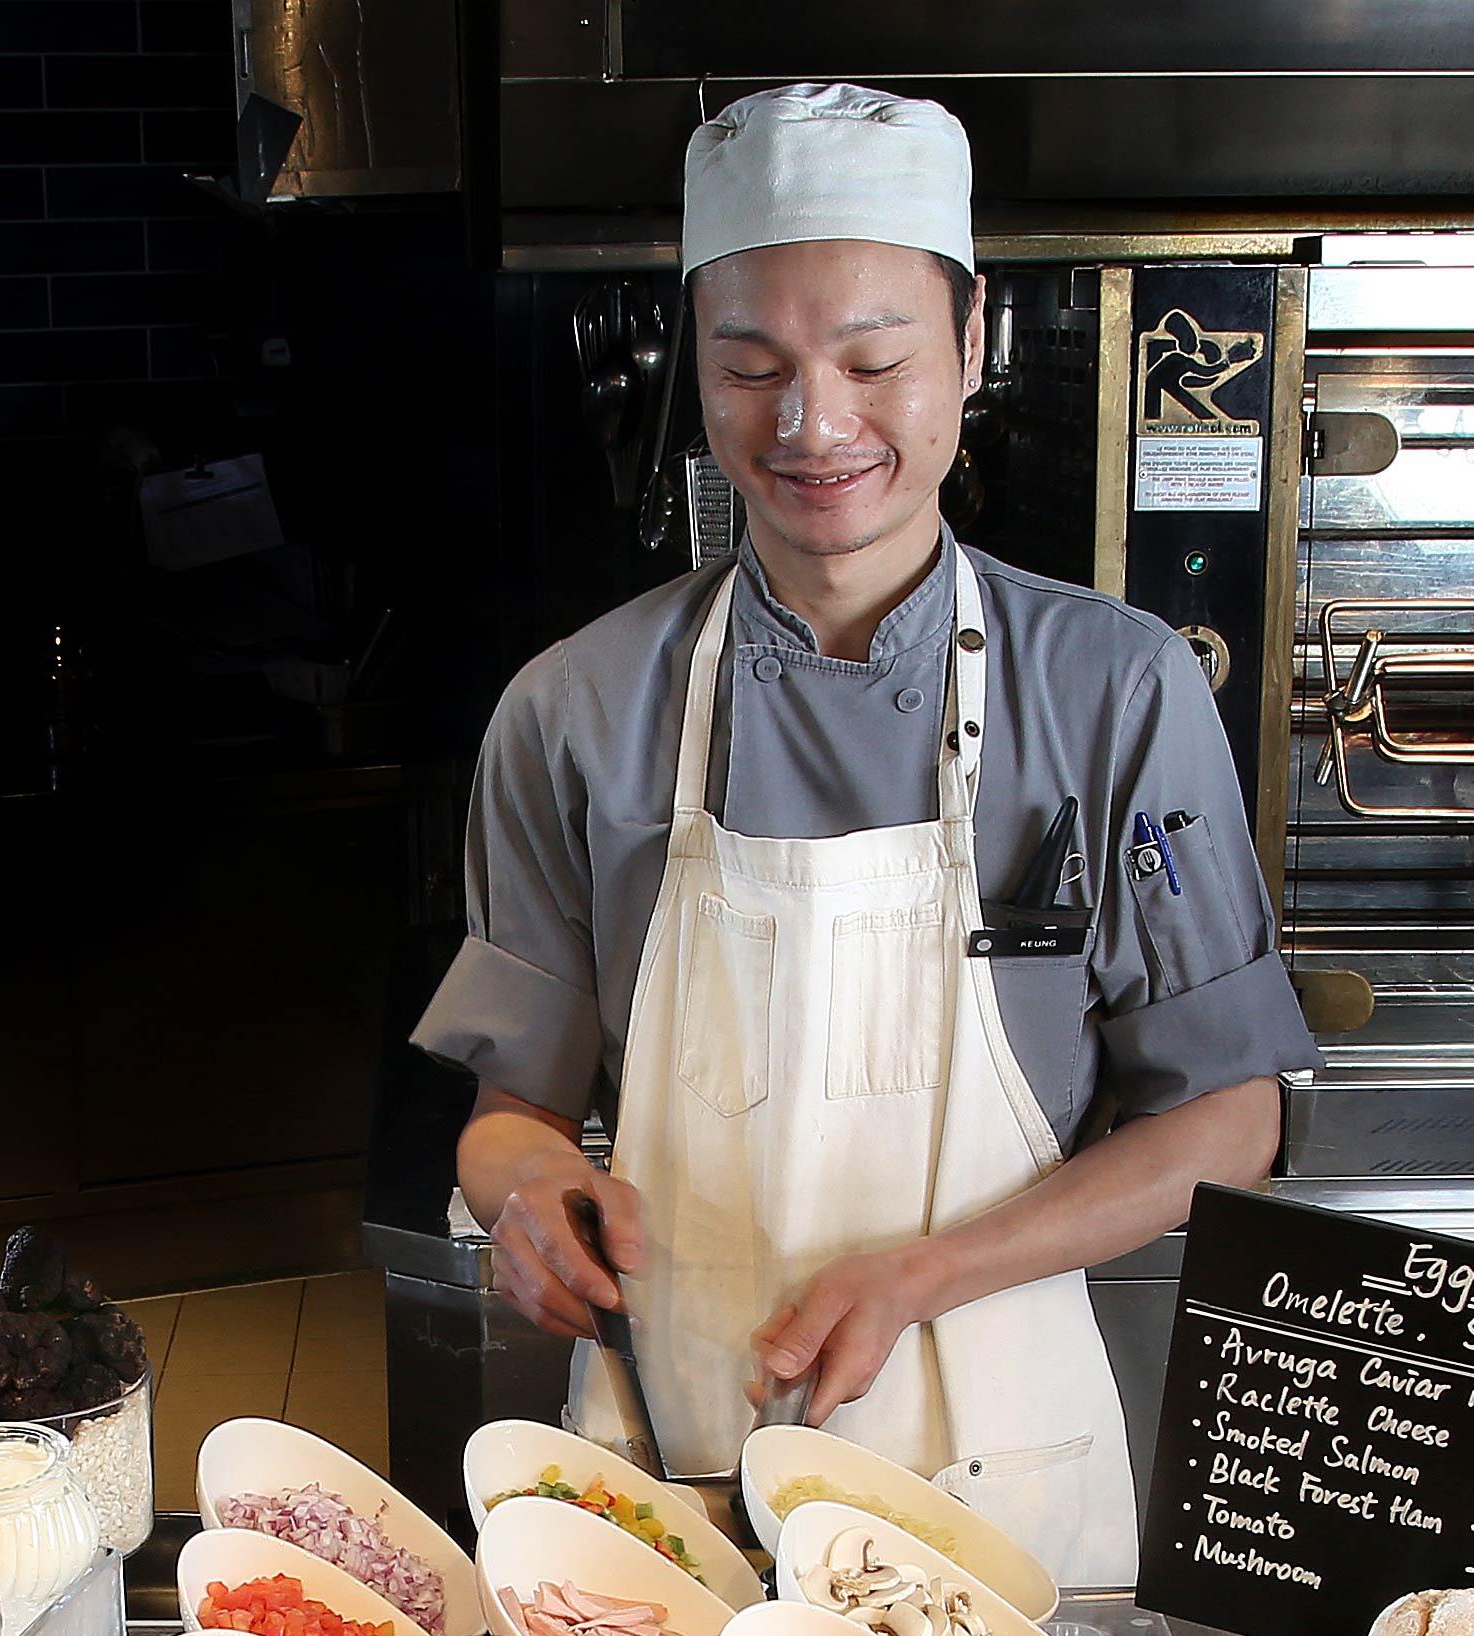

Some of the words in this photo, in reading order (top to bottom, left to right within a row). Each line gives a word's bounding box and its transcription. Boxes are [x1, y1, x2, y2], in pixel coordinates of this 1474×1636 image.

[1221, 1329, 1336, 1389] Avruga
[1361, 1359, 1451, 1402] Caviar
[1216, 1374, 1340, 1426] Raclette
[1368, 1406, 1450, 1449] Cheese
[1208, 1413, 1306, 1460] Smoked
[1324, 1437, 1419, 1484] Salmon
[1204, 1495, 1295, 1539] Tomato
[1209, 1456, 1280, 1494] Black
[1299, 1474, 1377, 1520] Forest
[1389, 1498, 1443, 1533] Ham
[1194, 1534, 1322, 1590] Mushroom
